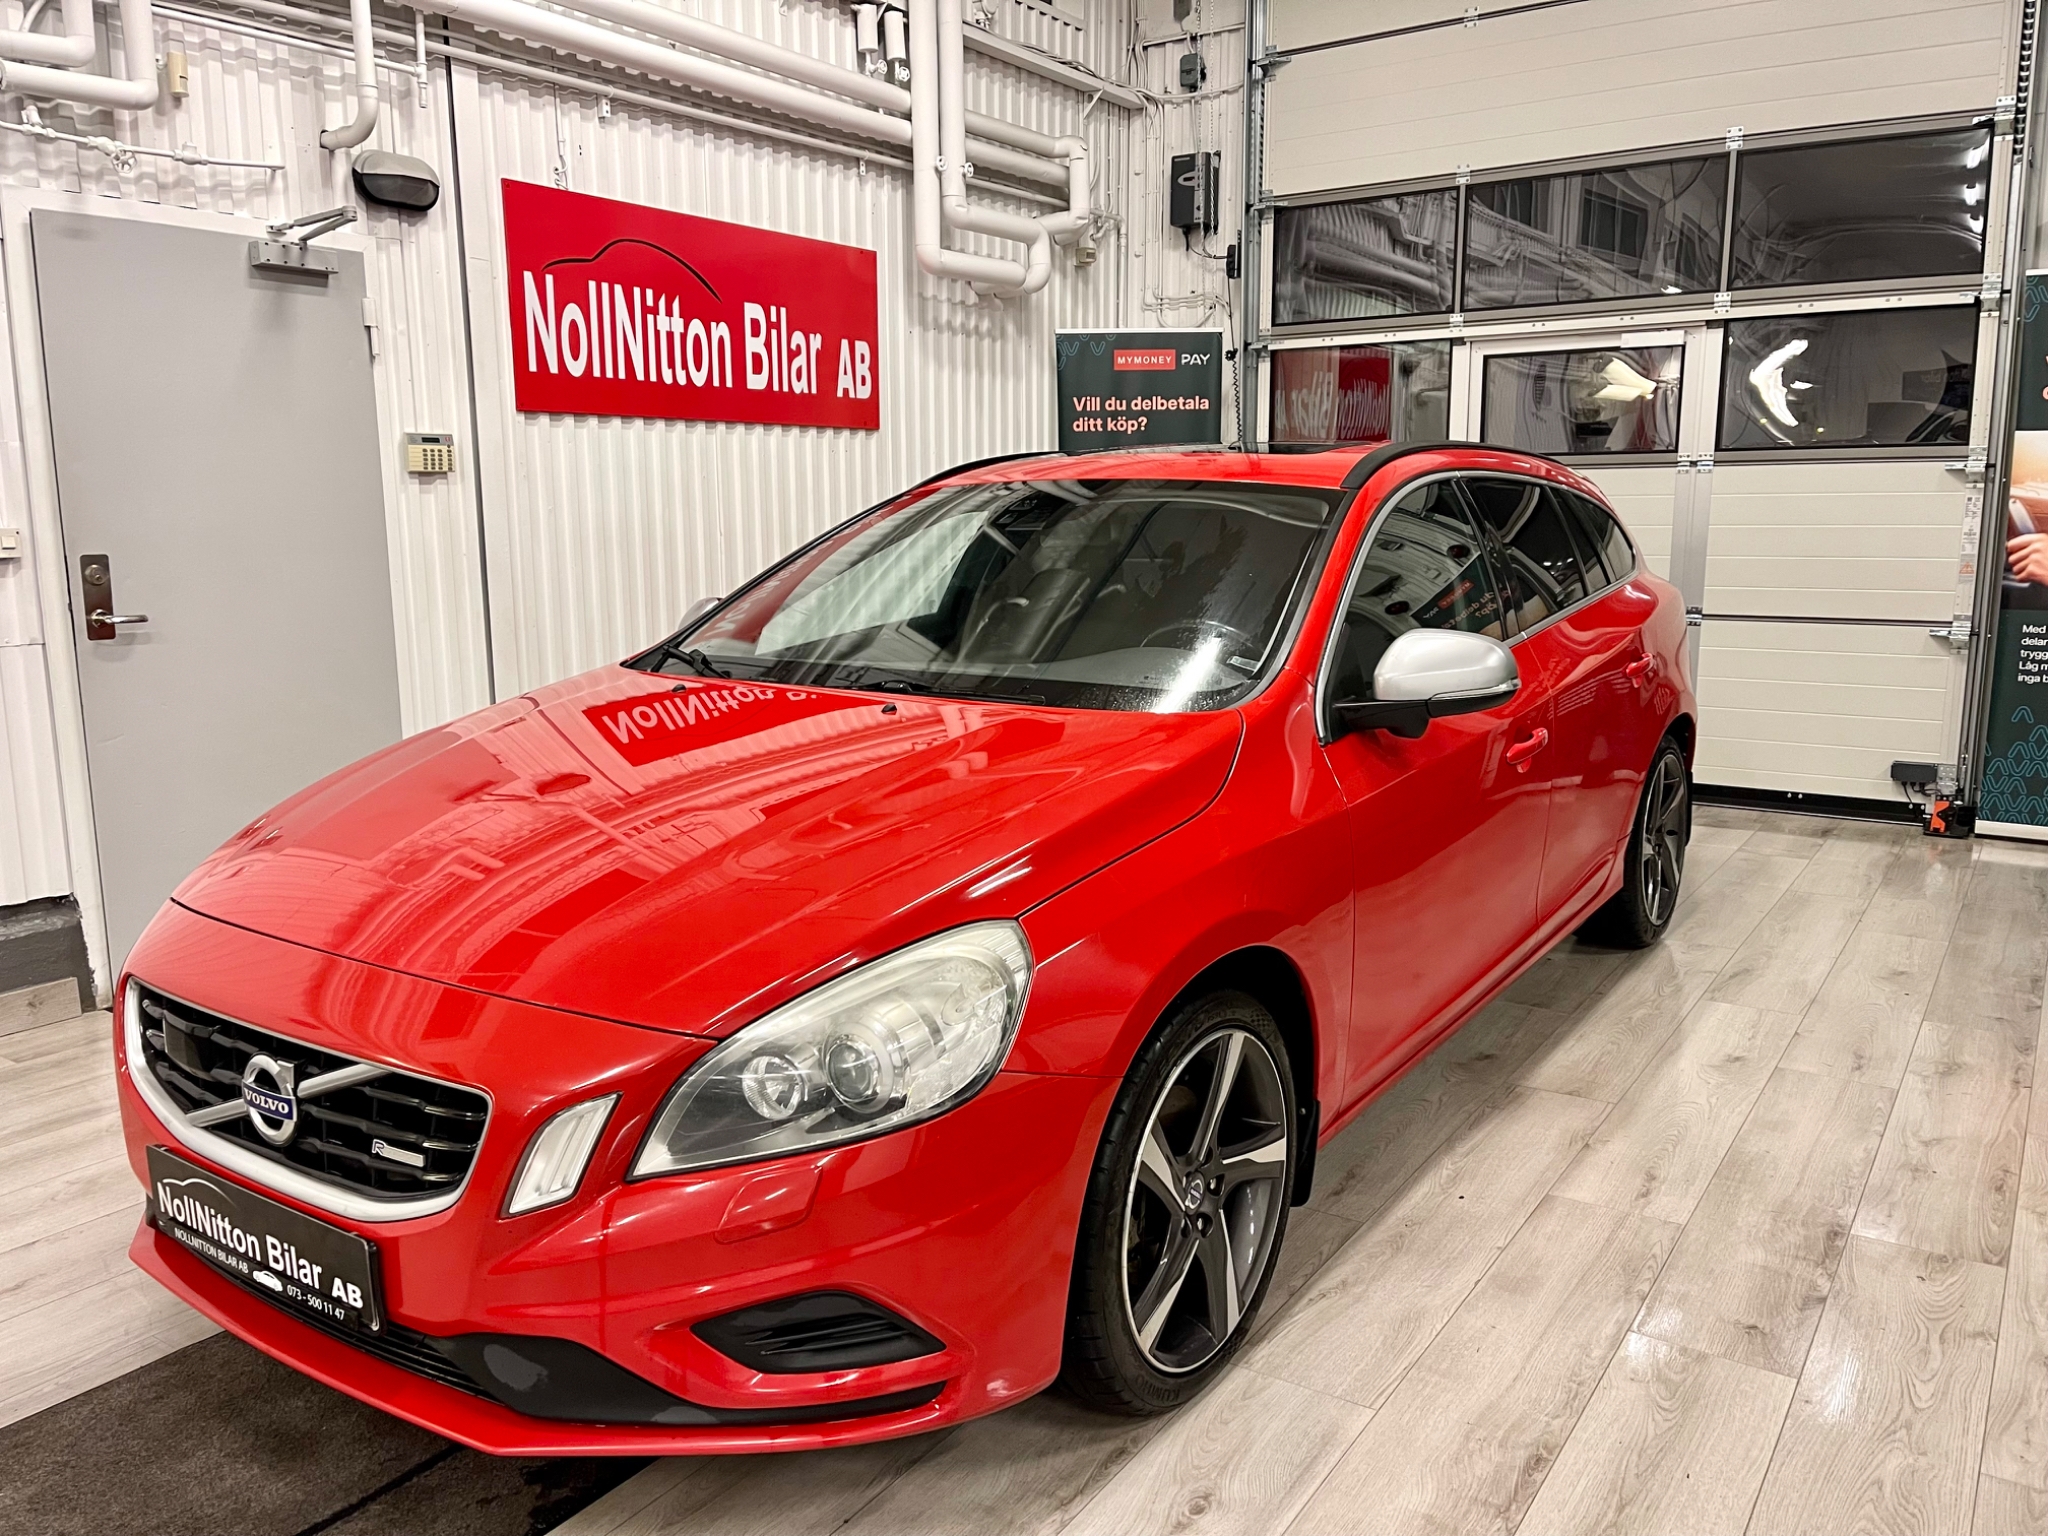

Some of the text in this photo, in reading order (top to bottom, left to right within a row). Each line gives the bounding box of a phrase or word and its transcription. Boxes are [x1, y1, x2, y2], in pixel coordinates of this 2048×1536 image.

[523, 270, 873, 399] NollNitton Bilar AB
[1117, 353, 1211, 365] MYMONEY PAY
[1073, 395, 1210, 411] Vill du delbetala
[1073, 415, 1148, 435] ditt köp?
[2022, 624, 2047, 634] Med
[2017, 672, 2041, 684] inga
[243, 1087, 289, 1114] VOLVO
[372, 1139, 387, 1156] R
[157, 1181, 363, 1309] NollNitton Bilar AB
[174, 1227, 217, 1258] NOLLNITTON
[217, 1249, 238, 1269] BILAR
[238, 1260, 249, 1274] AB
[286, 1284, 302, 1300] 073
[307, 1293, 323, 1311] 500
[323, 1301, 333, 1316] 11
[334, 1307, 345, 1321] 47
